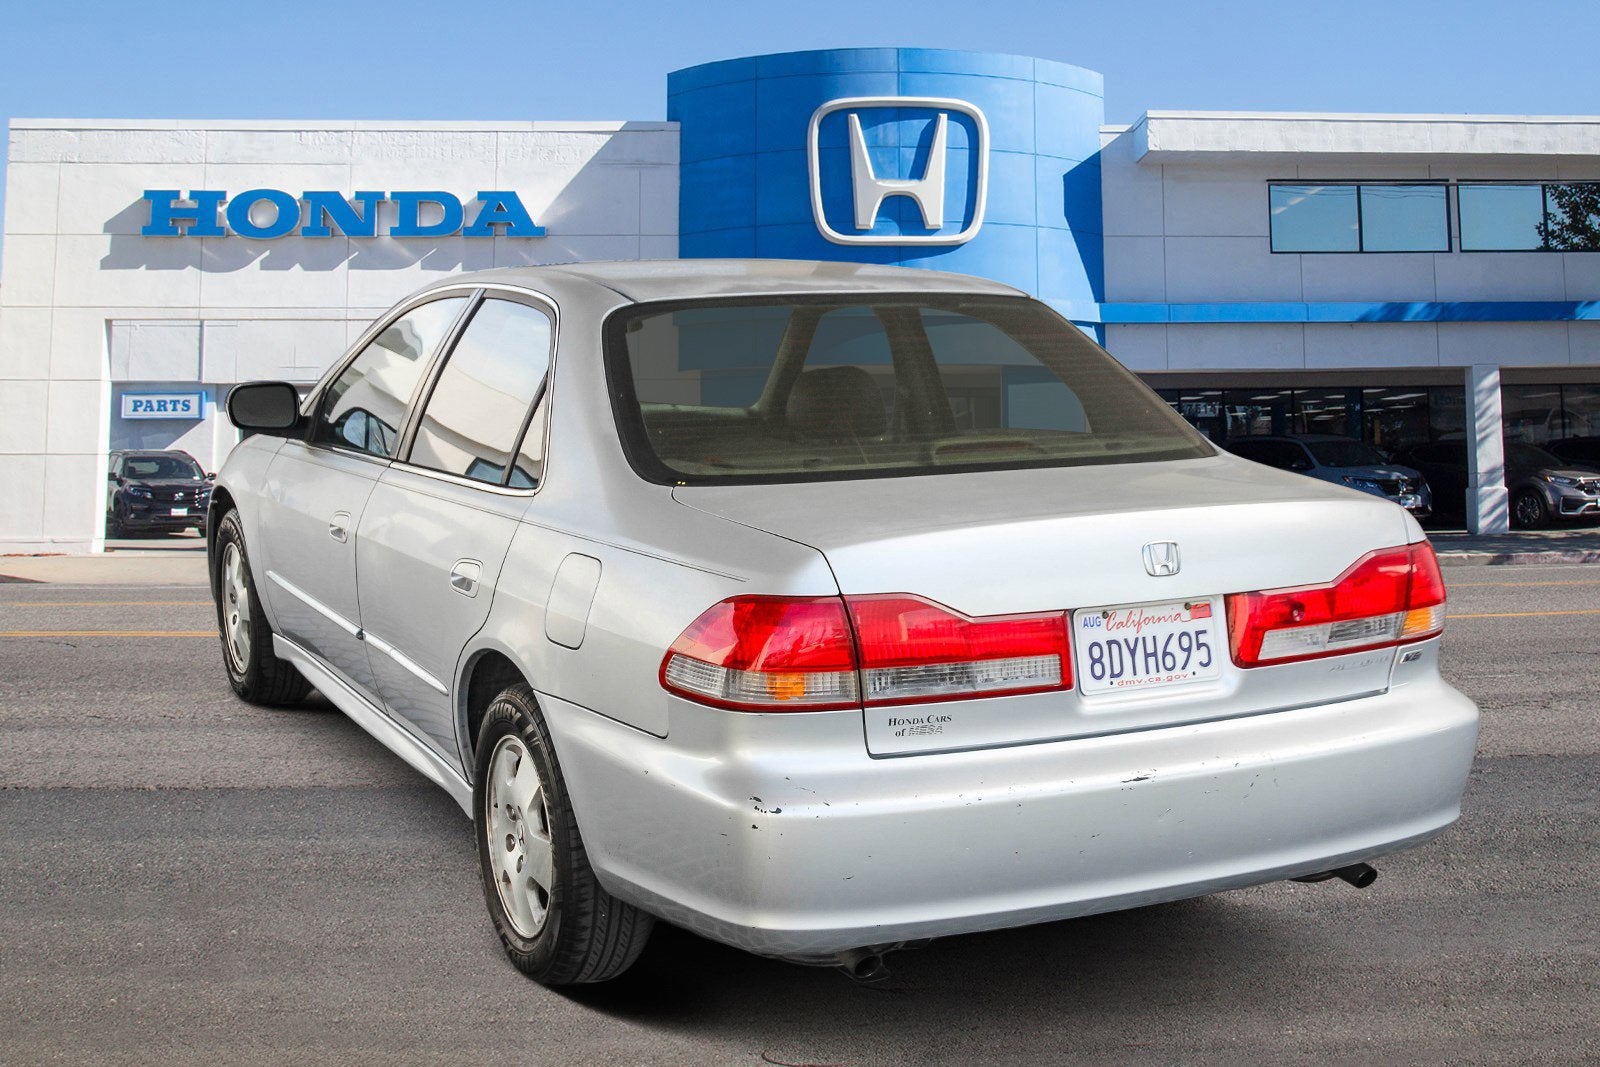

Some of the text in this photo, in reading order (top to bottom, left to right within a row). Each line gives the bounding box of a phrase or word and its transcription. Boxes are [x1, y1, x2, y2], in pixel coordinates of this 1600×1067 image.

[141, 189, 546, 239] HONDA
[131, 399, 191, 412] PARTS
[1083, 616, 1101, 628] AUG
[1105, 609, 1188, 634] California
[1088, 630, 1212, 681] 8DYH695
[1117, 672, 1188, 687] dmv.ca.gov
[888, 715, 952, 726] HONDA CARS
[895, 725, 943, 737] of MESA
